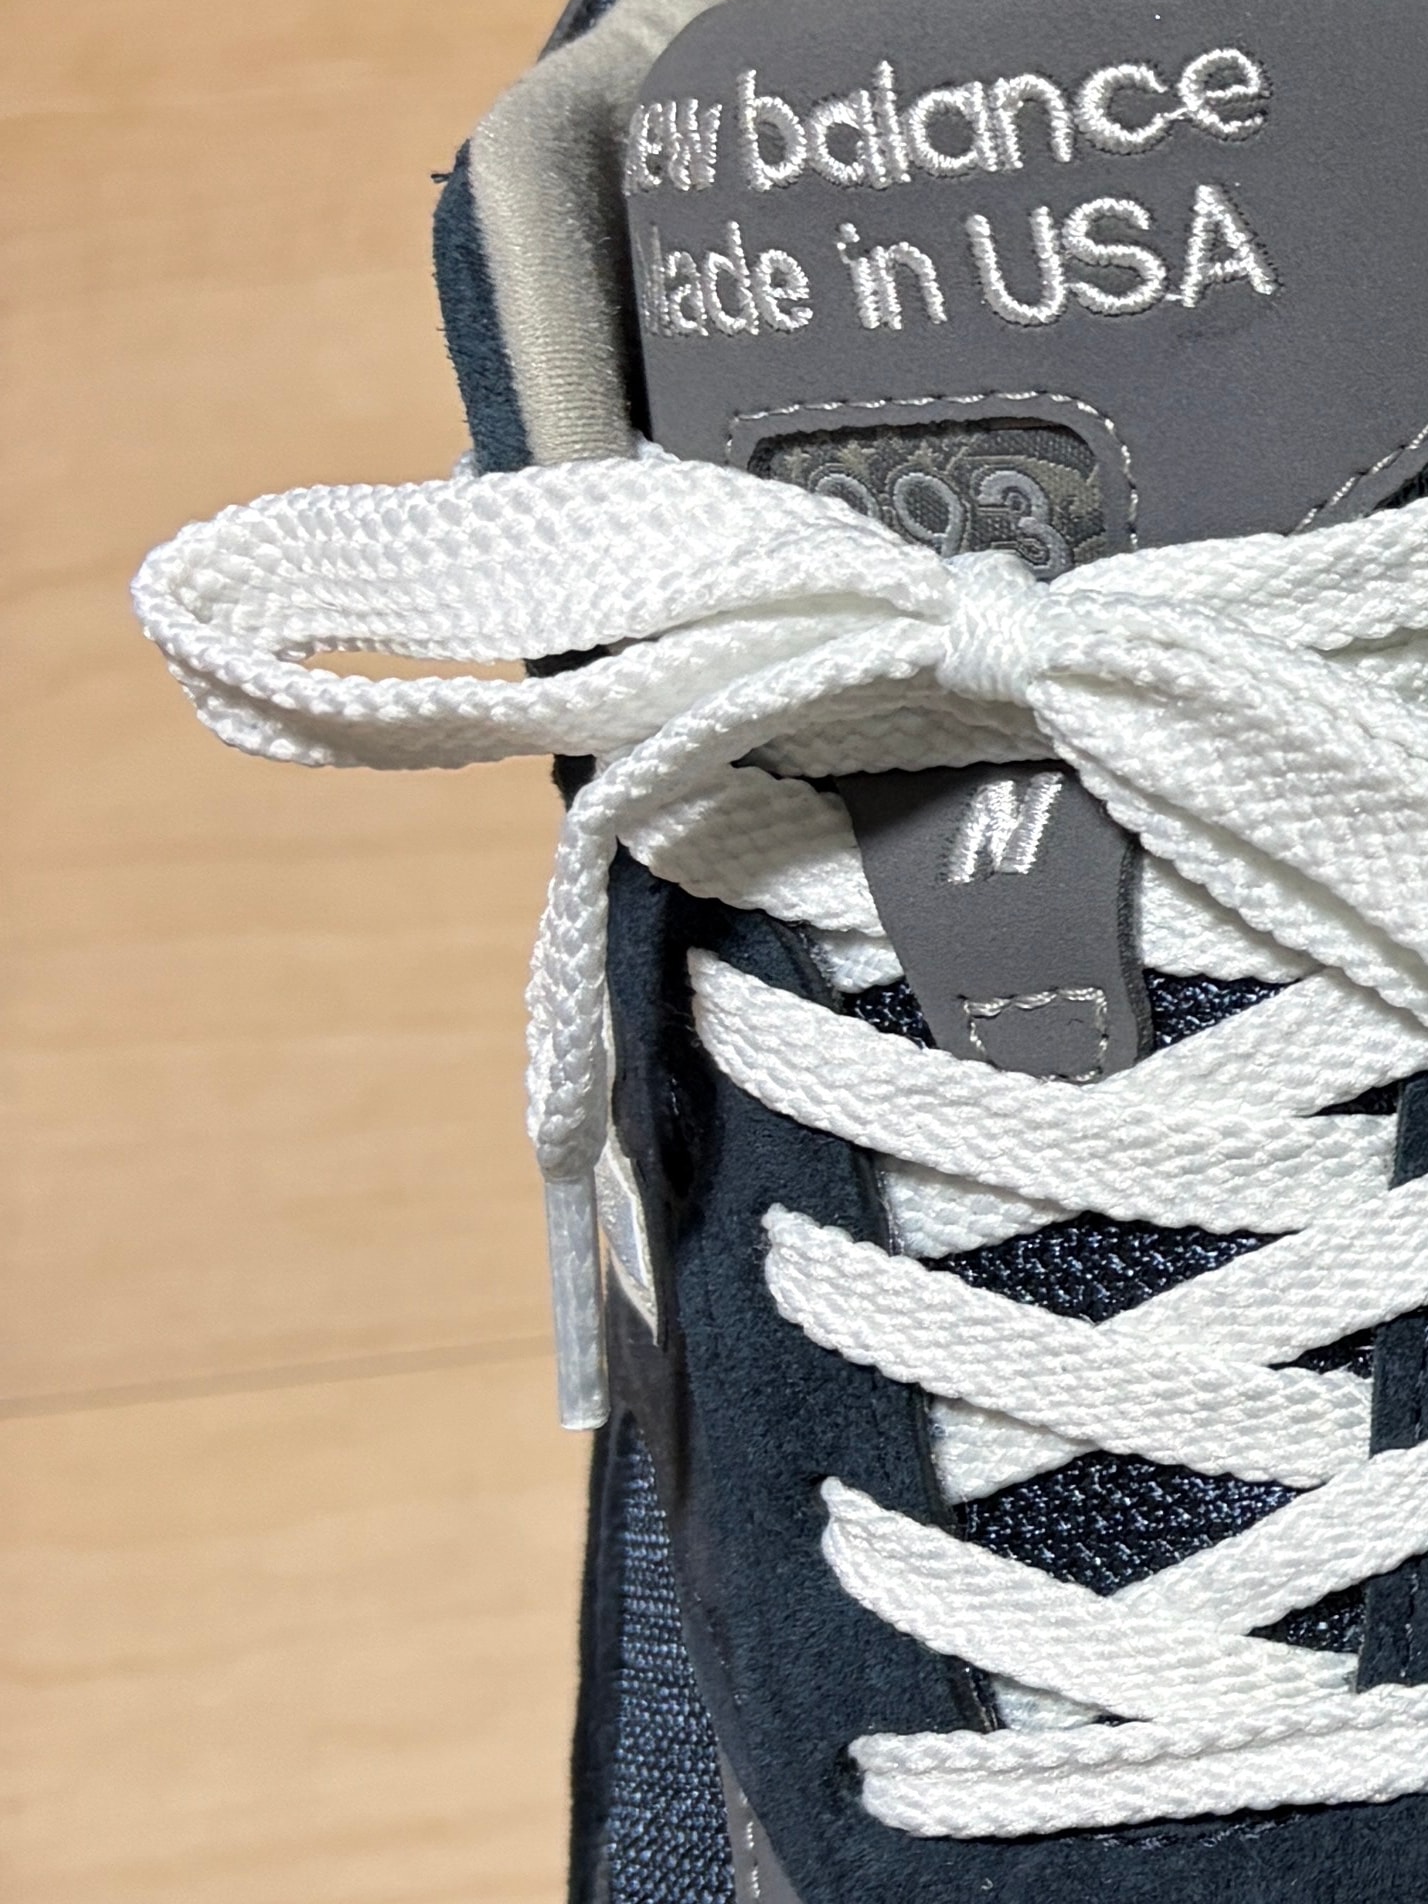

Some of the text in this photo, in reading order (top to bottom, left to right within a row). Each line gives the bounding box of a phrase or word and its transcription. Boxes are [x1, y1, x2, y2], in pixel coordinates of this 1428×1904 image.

[736, 46, 1270, 192] balance
[836, 221, 947, 330] in
[963, 184, 1281, 326] USA
